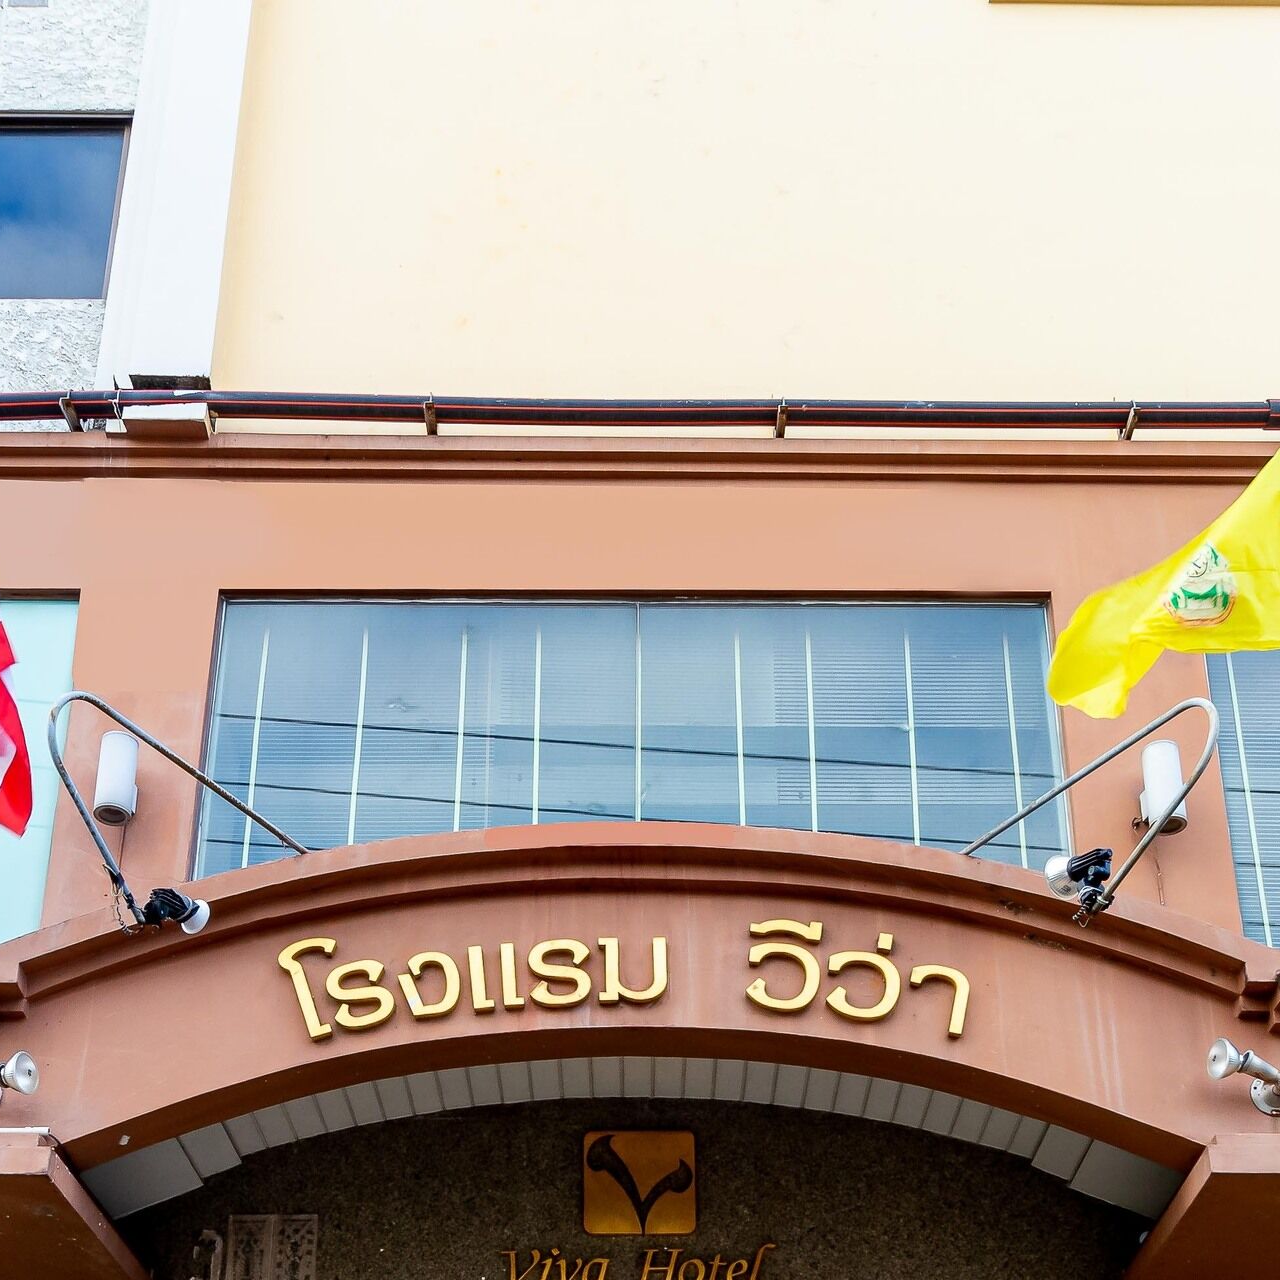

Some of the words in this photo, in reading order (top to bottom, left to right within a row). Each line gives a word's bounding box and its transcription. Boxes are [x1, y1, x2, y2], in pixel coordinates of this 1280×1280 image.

[277, 935, 669, 1041] โรงแรม
[744, 918, 972, 1037] วีว่า
